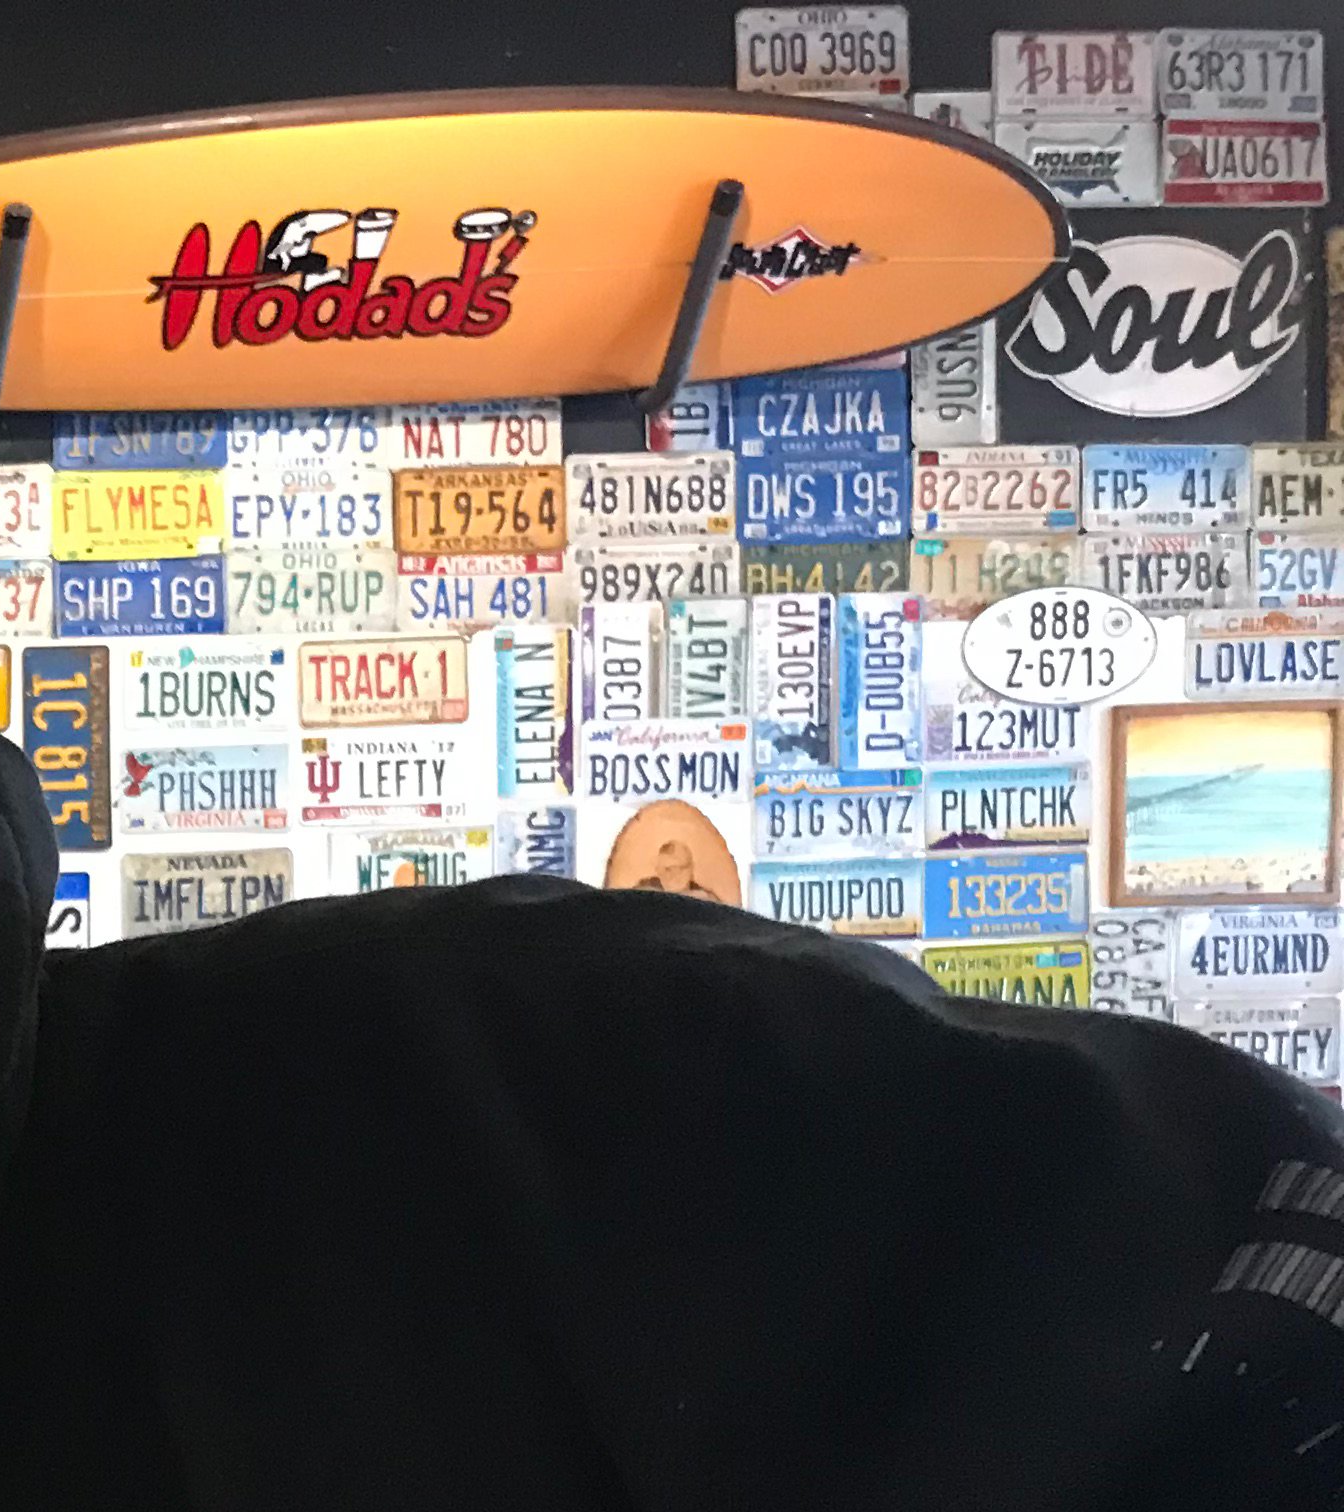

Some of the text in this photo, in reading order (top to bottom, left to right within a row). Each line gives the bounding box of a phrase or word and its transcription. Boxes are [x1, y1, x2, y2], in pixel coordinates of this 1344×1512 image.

[819, 30, 897, 78] 3969
[1257, 50, 1310, 93] 171
[1033, 151, 1123, 168] HOLIDAY
[1009, 230, 1302, 377] Soul
[403, 413, 549, 460] NAT 780
[149, 575, 218, 619] 169
[488, 576, 549, 619] 481
[1029, 599, 1091, 642] 888
[308, 647, 419, 700] TRACK
[357, 758, 448, 801] LEFTY
[589, 751, 740, 798] BOSS MON
[769, 797, 825, 839] BIG
